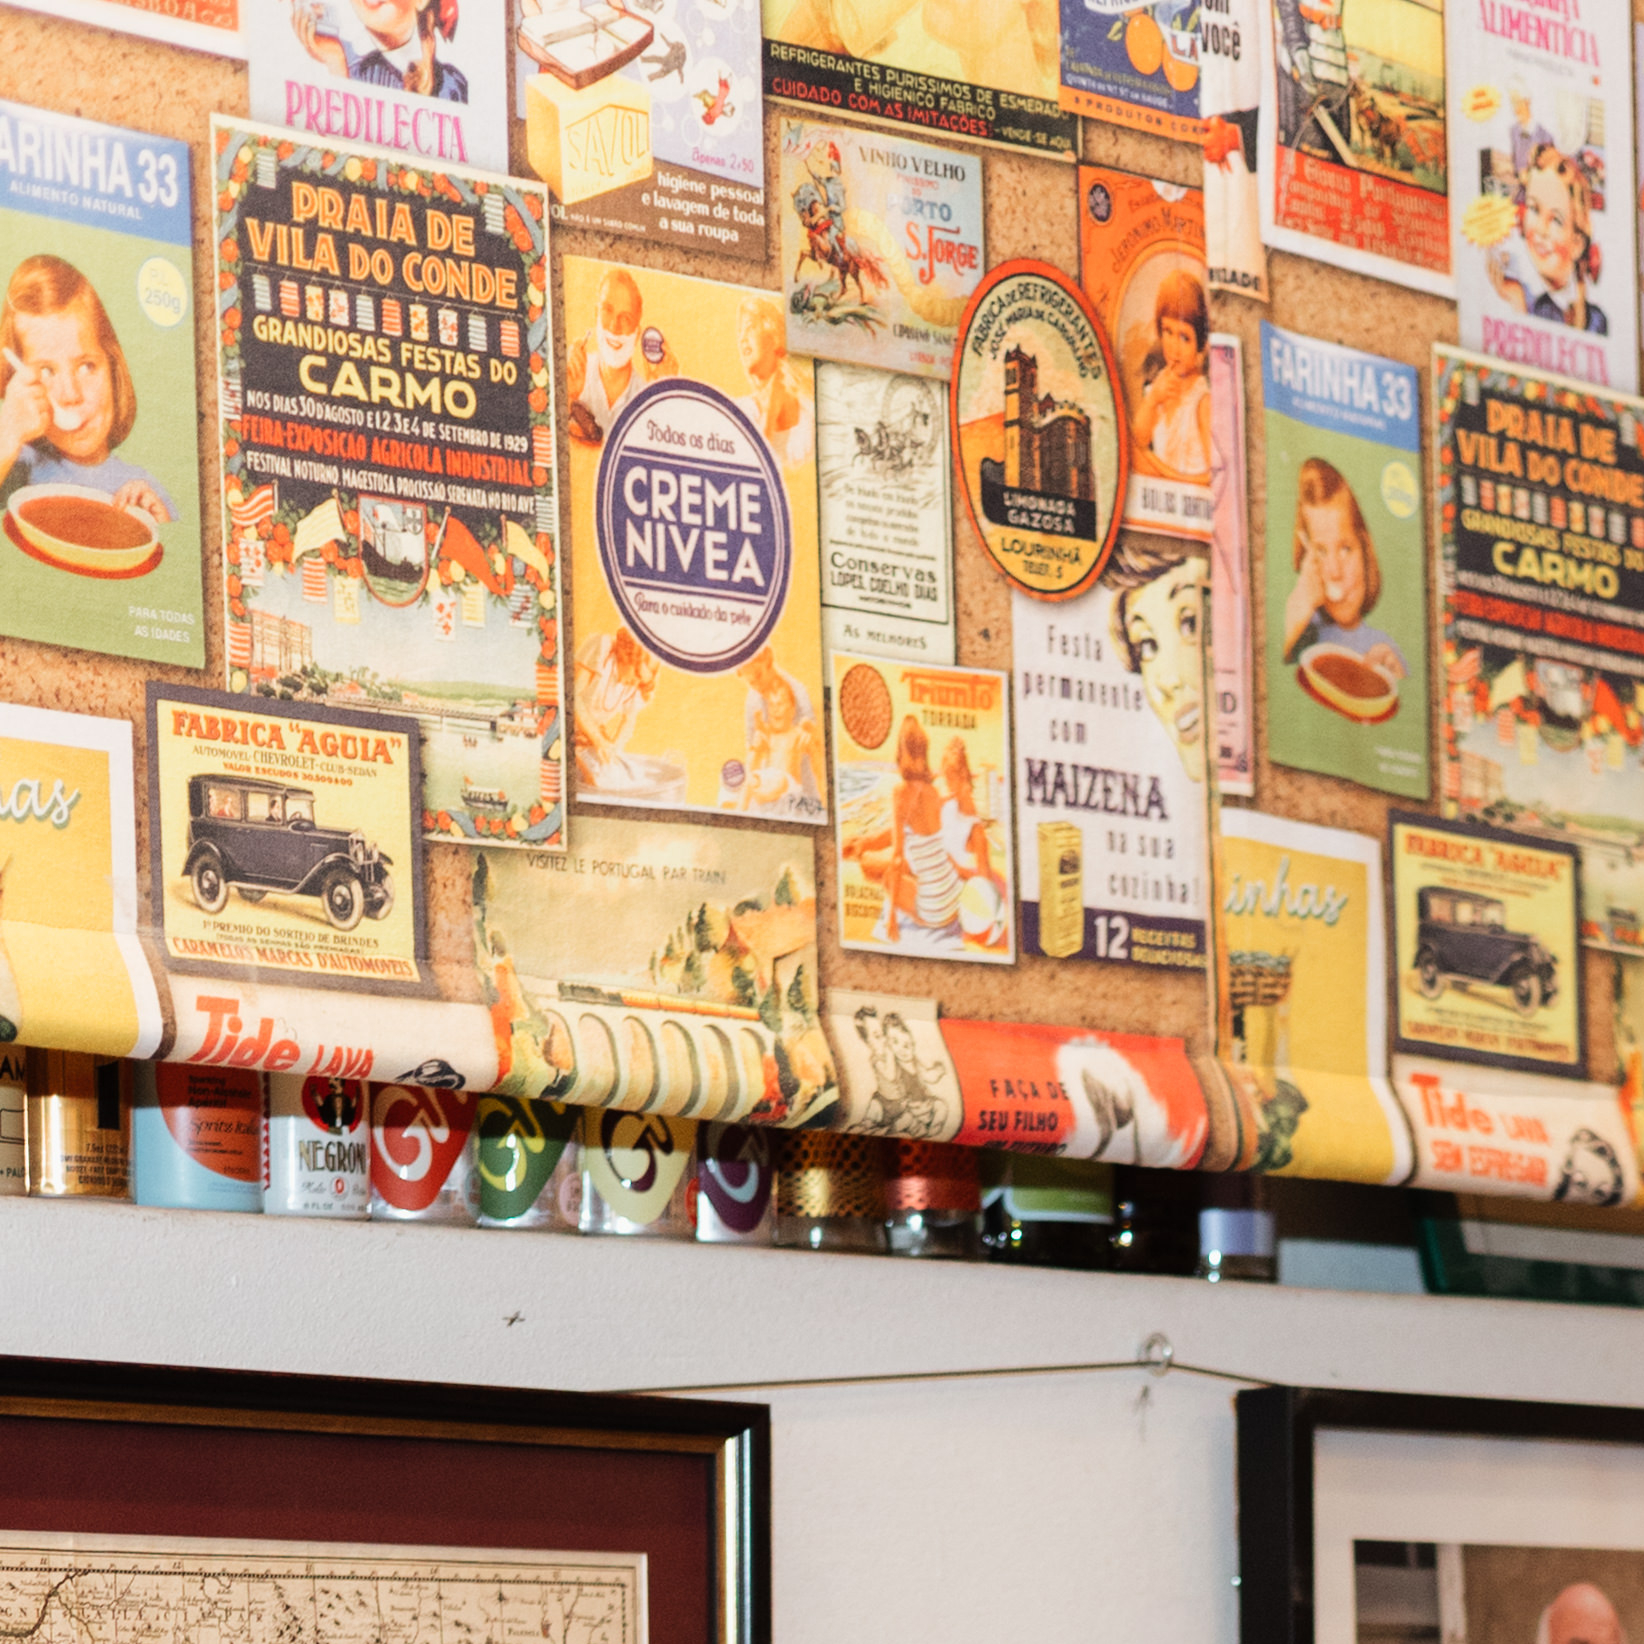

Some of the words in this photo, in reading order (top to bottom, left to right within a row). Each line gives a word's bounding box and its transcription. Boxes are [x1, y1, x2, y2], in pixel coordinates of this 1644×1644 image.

[770, 43, 880, 81] REFRIGERANTES
[886, 69, 970, 100] PURISSIMOS
[976, 90, 992, 104] DE
[772, 77, 842, 106] CUIDADO
[848, 92, 881, 113] COM
[884, 103, 903, 118] AS
[854, 79, 862, 92] E
[869, 83, 934, 108] HIGIENICO
[940, 100, 996, 120] FABRICO
[284, 78, 469, 164] PREDILECTA
[136, 149, 179, 208] 33
[859, 146, 907, 171] VINHO
[912, 156, 966, 181] VELHO
[10, 180, 79, 206] ALIMENTO
[83, 194, 143, 220] NATURAL
[641, 193, 650, 206] e
[653, 191, 710, 216] lavagem
[713, 203, 730, 220] de
[733, 206, 764, 226] toda
[657, 172, 707, 194] higiene
[710, 184, 764, 206] pessoal
[292, 181, 417, 245] PRAIA
[426, 209, 475, 256] DE
[659, 217, 668, 229] a
[671, 219, 694, 234] sua
[698, 223, 739, 244] roupa
[246, 218, 340, 276] VILA
[348, 244, 394, 285] DO
[403, 254, 518, 309] CONDE
[144, 290, 181, 313] 250g
[253, 315, 391, 364] GRANDIOSAS
[401, 342, 481, 379] FESTAS
[489, 357, 517, 385] DO
[1482, 313, 1611, 387] PREDILECTA
[299, 355, 477, 419] CARMO
[1270, 337, 1380, 413] FARINHA
[1382, 371, 1412, 421] 33
[248, 390, 271, 408] NOS
[273, 393, 299, 415] DIAS
[423, 420, 436, 437] DE
[439, 423, 488, 447] SETEMBRO
[490, 434, 501, 449] DE
[504, 434, 528, 453] 1929
[647, 420, 686, 447] Todos
[690, 434, 704, 450] os
[708, 433, 735, 454] dias
[1486, 399, 1575, 461] PRAIA
[1579, 422, 1616, 465] DE
[248, 450, 291, 477] FESTIVAL
[343, 468, 395, 492] MAGESTOSA
[372, 439, 441, 474] AGRICOLA
[446, 450, 533, 487] INDUSTRIAL
[1456, 427, 1523, 478] VILA
[1527, 451, 1561, 487] DO
[624, 465, 762, 534] CREME
[1003, 491, 1075, 516] LIMONADA
[1007, 509, 1075, 534] GAZOSA
[626, 518, 765, 587] NIVEA
[831, 552, 937, 583] Conservas
[1001, 537, 1081, 565] LOURINHÃ
[1492, 540, 1620, 599] CARMO
[128, 605, 158, 623] PARA
[160, 609, 195, 625] TODAS
[634, 592, 660, 613] Para
[662, 605, 668, 615] o
[671, 603, 713, 621] cuidado
[715, 608, 728, 624] da
[730, 609, 751, 626] pele
[134, 624, 150, 638] AS
[152, 627, 191, 644] IDADES
[867, 630, 927, 649] MELHORES
[1047, 624, 1104, 662] Festa
[1023, 671, 1143, 711] permanente
[171, 709, 287, 750] FABRICA
[923, 709, 977, 730] TORRADA
[1050, 716, 1087, 745] com
[223, 761, 251, 773] VALOR
[255, 766, 299, 779] ESCUDOS
[1026, 756, 1169, 822] MAIZENA
[1138, 831, 1176, 861] sua
[527, 853, 567, 872] VISITEZ
[573, 857, 586, 874] LE
[591, 859, 656, 881] PORTUGAL
[663, 865, 688, 883] PAR
[692, 867, 727, 886] TRAIN
[173, 937, 250, 960] CARAMELOS
[256, 946, 313, 968] MARCAS
[213, 921, 253, 934] PREMIO
[256, 925, 271, 937] DO
[273, 927, 315, 941] SORTEIO
[318, 933, 330, 943] DE
[333, 935, 379, 948] BRINDES
[1094, 915, 1129, 959] 12
[187, 993, 301, 1073] Tide
[309, 1043, 374, 1080] LAVA
[990, 1079, 1041, 1101] FAÇA
[1047, 1081, 1069, 1100] DE
[1410, 1072, 1494, 1135] Tide
[978, 1110, 1008, 1131] SEU
[1014, 1111, 1058, 1131] FILHO
